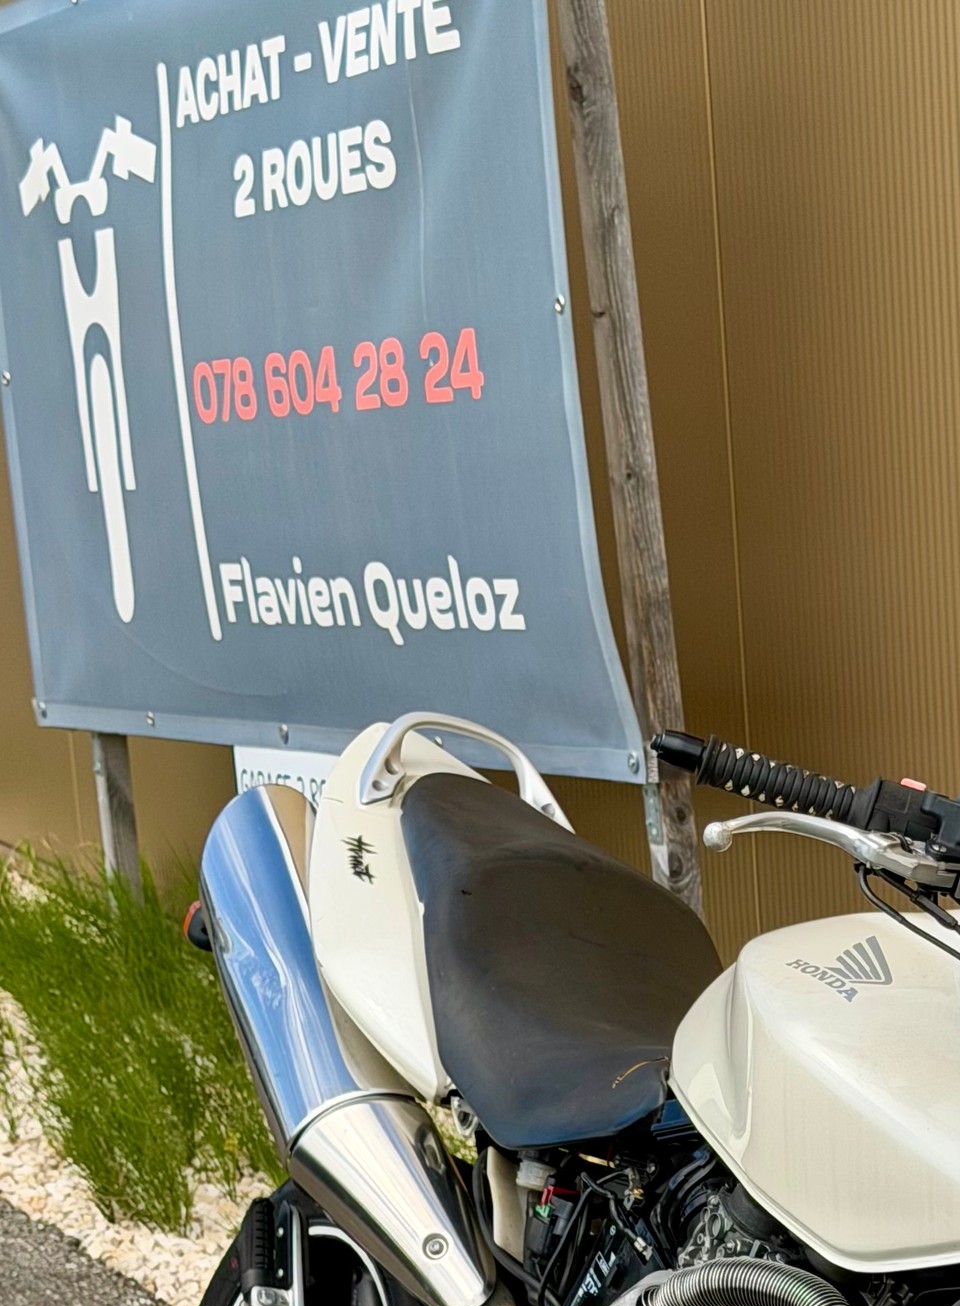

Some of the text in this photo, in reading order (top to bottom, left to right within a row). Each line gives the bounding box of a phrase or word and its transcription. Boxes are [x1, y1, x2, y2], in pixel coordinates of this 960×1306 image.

[176, 34, 286, 128] ACHAT
[317, 0, 461, 84] VENTE
[233, 119, 397, 218] 2 ROUES
[193, 327, 484, 424] 078 604 28 24
[219, 554, 527, 646] Flavien Queloz
[785, 958, 859, 1003] HONDA
